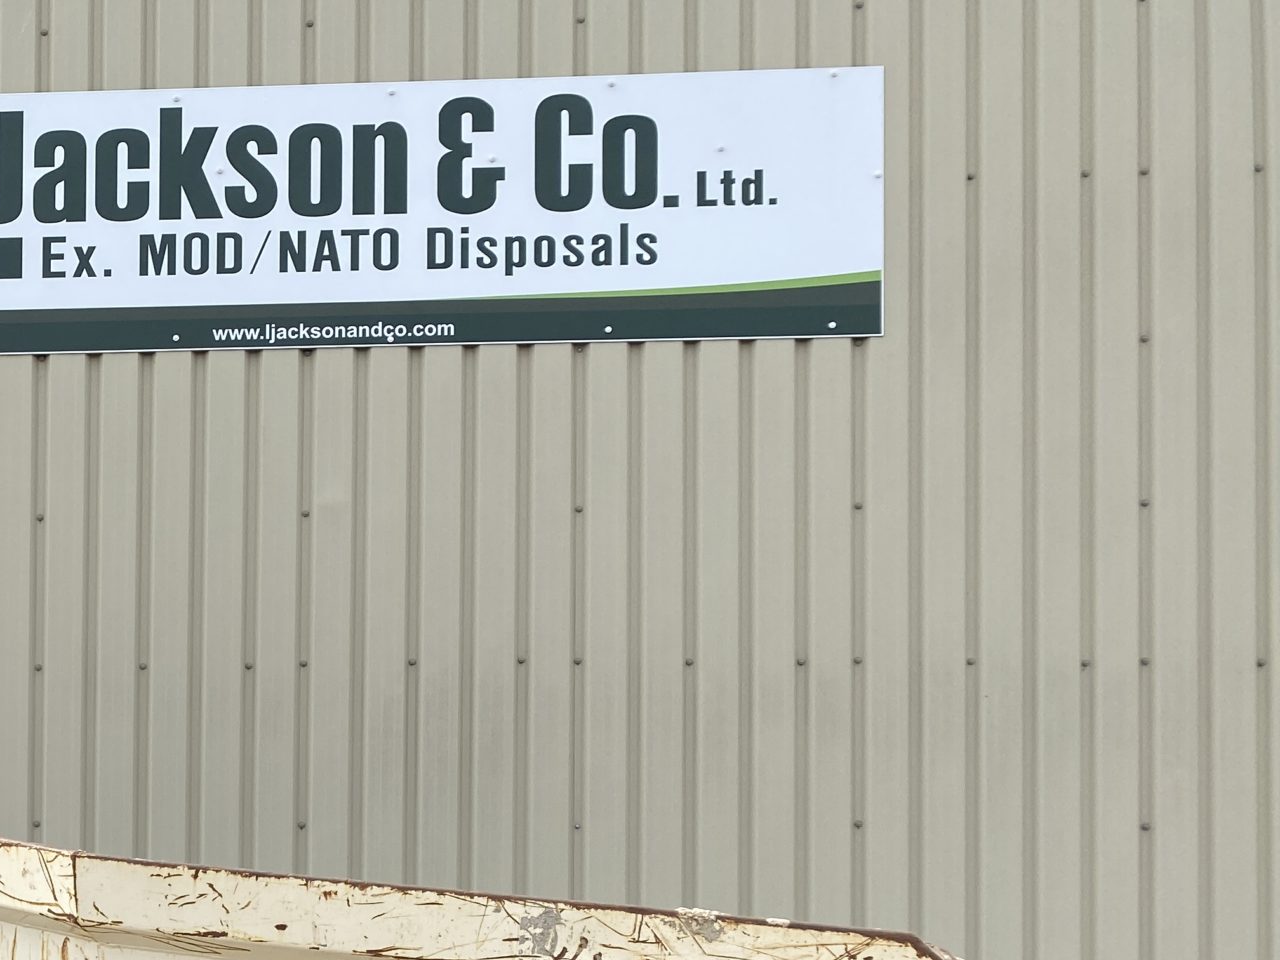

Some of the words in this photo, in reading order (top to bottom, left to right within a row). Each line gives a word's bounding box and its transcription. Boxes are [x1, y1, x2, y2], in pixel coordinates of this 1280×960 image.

[436, 96, 506, 215] &
[534, 93, 680, 213] Co.
[696, 169, 778, 207] Ltd.
[42, 236, 113, 279] Ex.
[139, 227, 399, 277] MOD/NATO
[426, 223, 658, 277] Disposals
[212, 321, 455, 344] www.ljacksonandco.com
